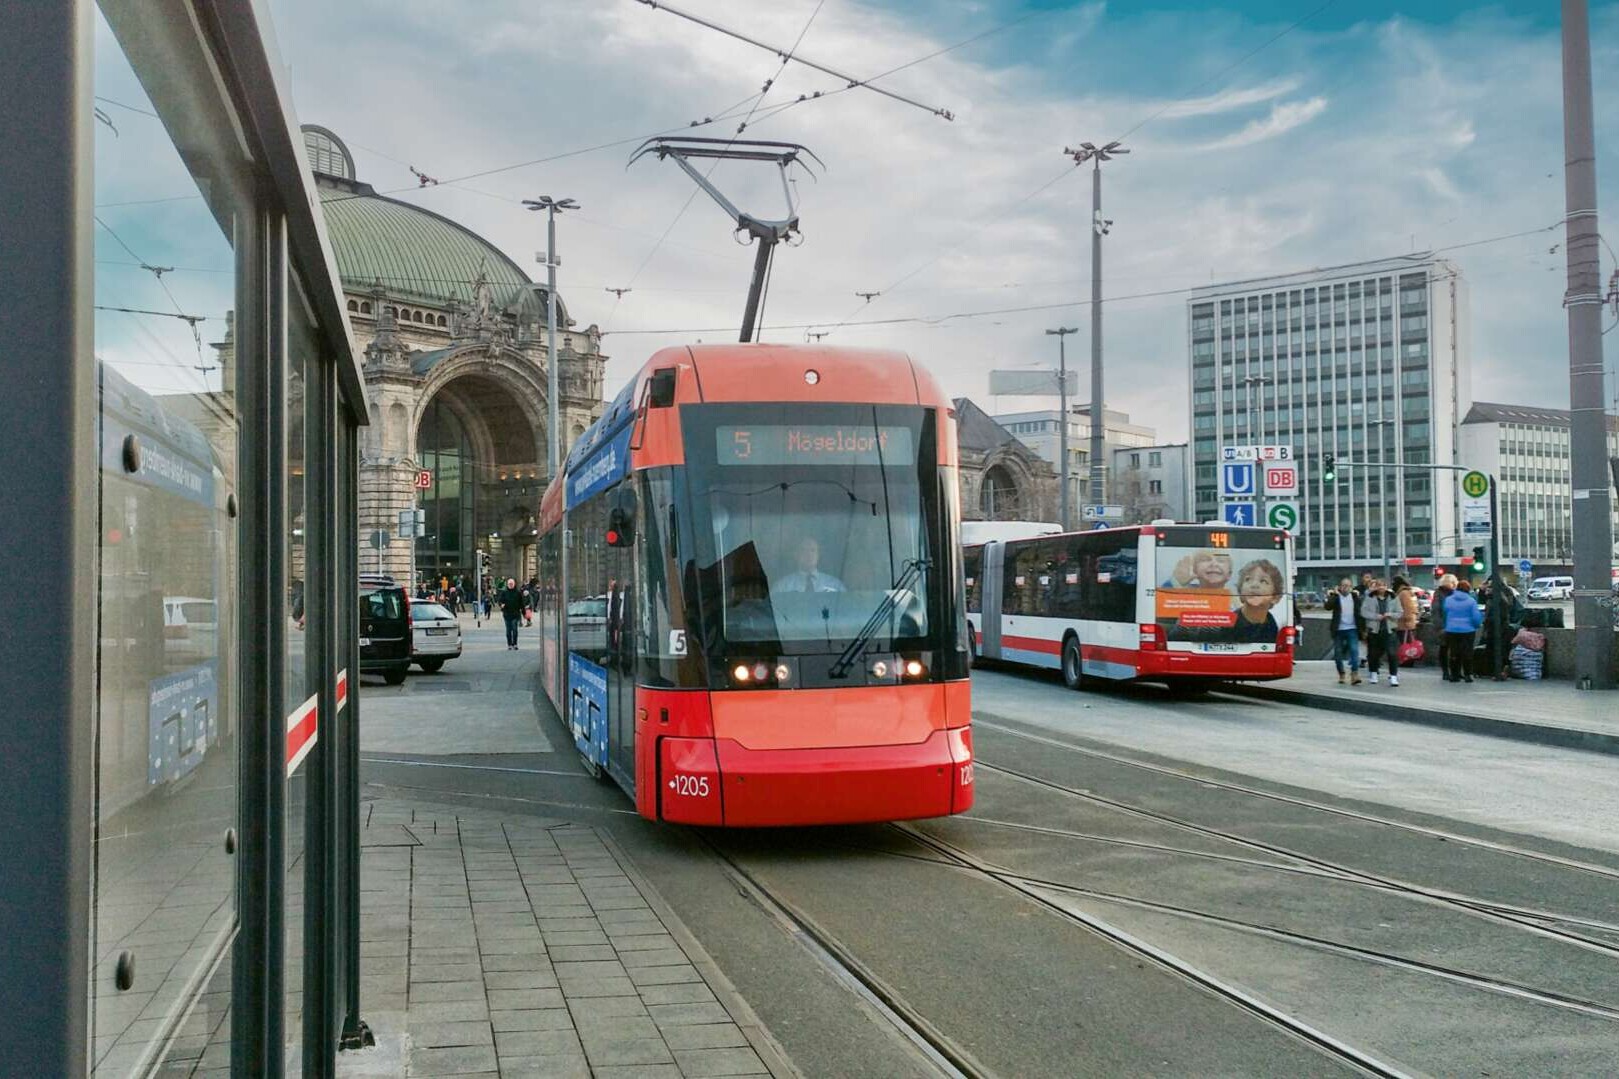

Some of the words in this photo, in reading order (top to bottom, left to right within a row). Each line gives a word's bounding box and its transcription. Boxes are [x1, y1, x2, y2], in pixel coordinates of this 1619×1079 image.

[735, 431, 751, 457] 5
[1280, 447, 1288, 459] B
[1227, 466, 1250, 492] U
[1270, 472, 1292, 486] DB
[1469, 477, 1482, 492] H
[1274, 507, 1291, 529] S
[675, 632, 685, 653] 5
[675, 774, 709, 797] 1205
